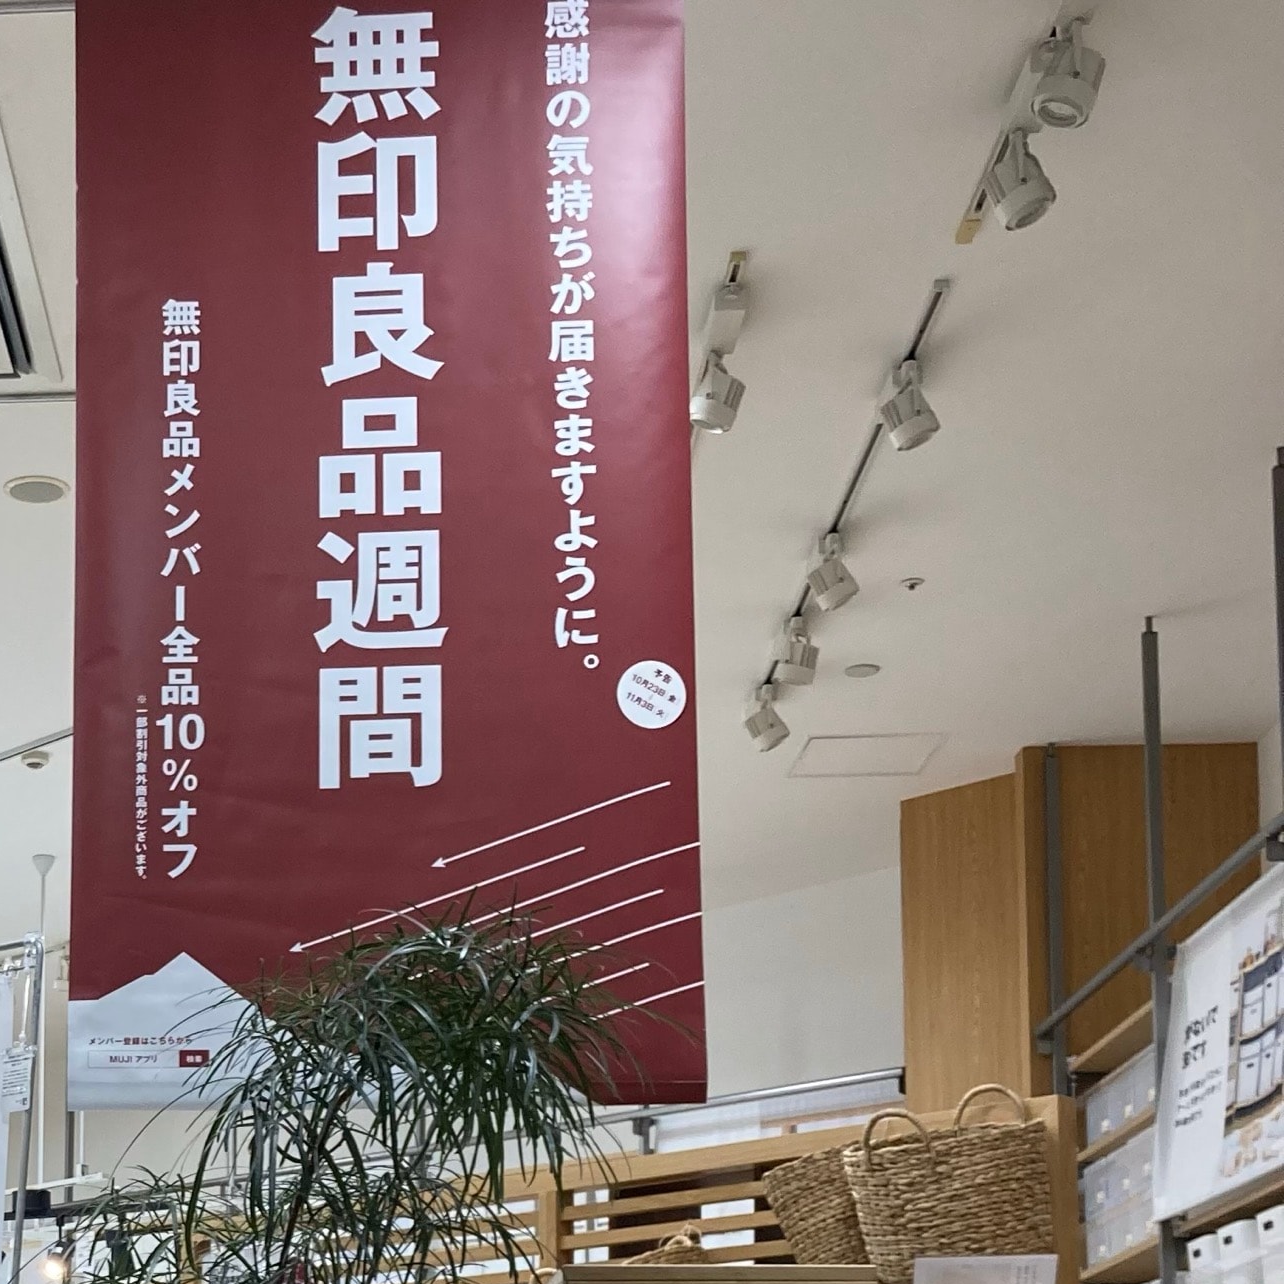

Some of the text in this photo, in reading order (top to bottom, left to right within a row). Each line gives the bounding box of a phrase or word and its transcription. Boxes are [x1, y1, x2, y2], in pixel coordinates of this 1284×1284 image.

[544, 0, 600, 669] 感謝の気持ちが届きますように。
[312, 6, 449, 789] 無印良品週間
[654, 668, 672, 684] 予告
[89, 1036, 194, 1046] メンバー登録はこちらから
[110, 1055, 158, 1063] MUJI アプリ
